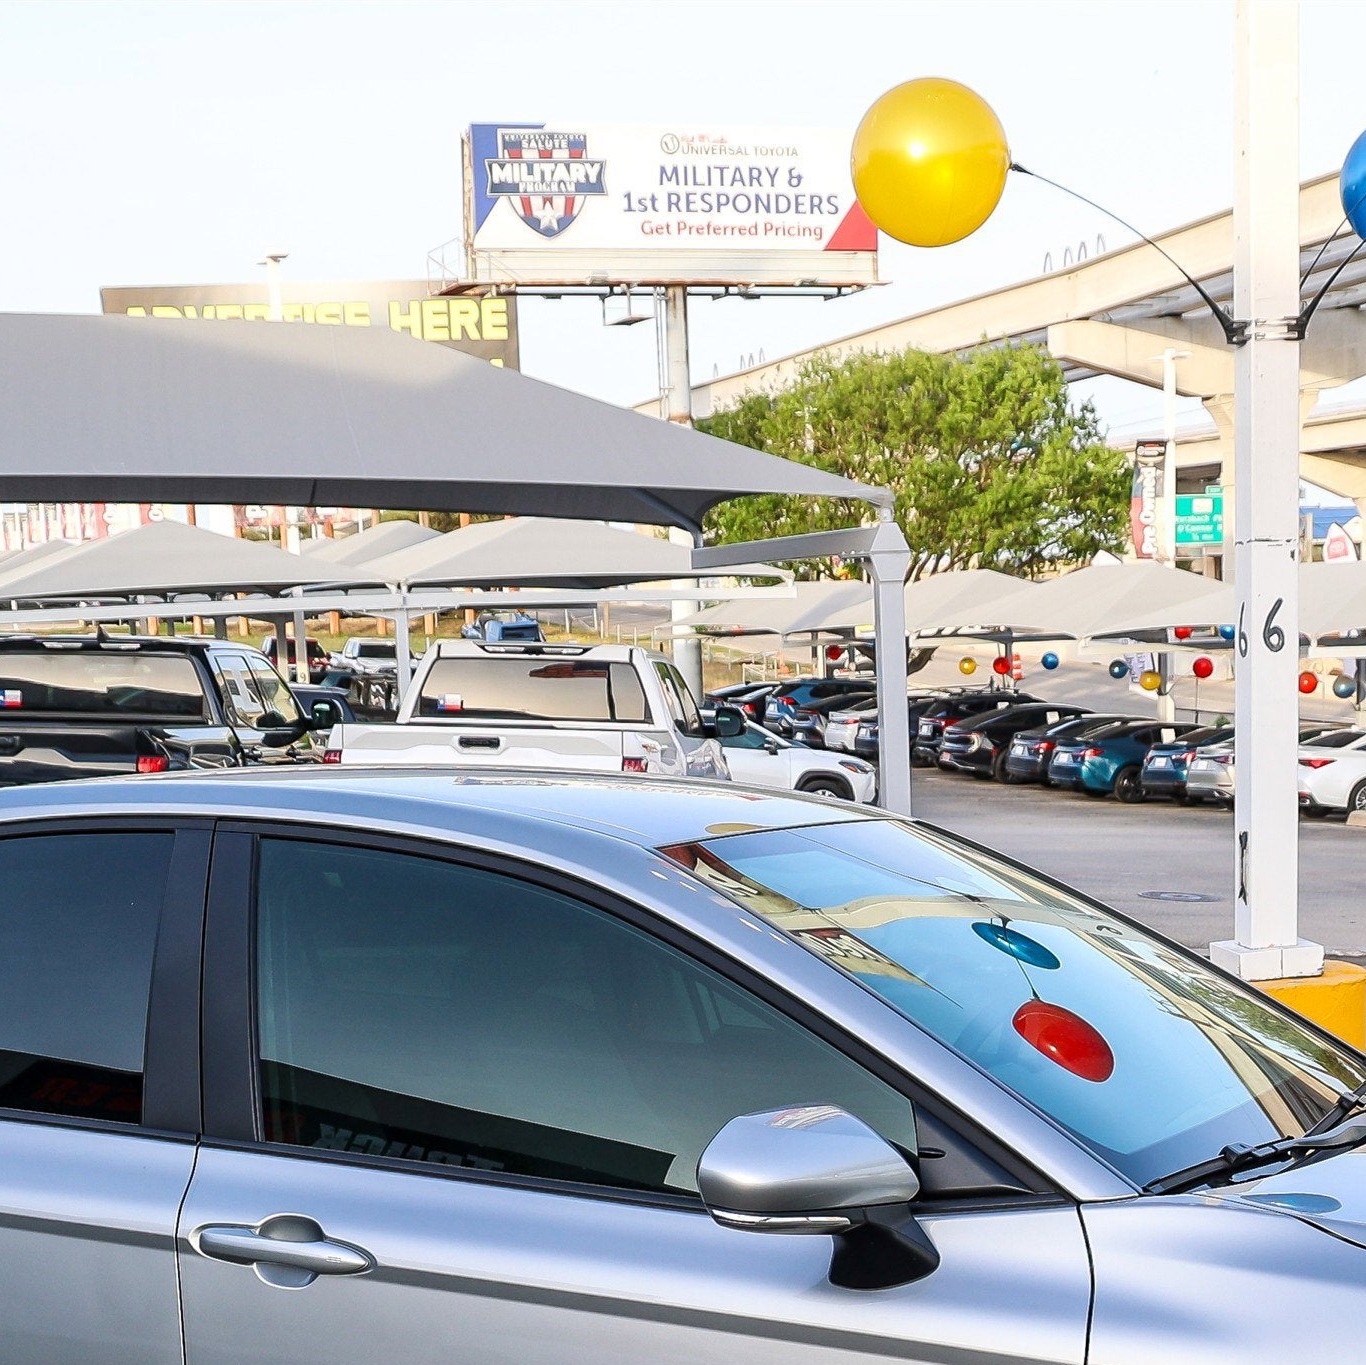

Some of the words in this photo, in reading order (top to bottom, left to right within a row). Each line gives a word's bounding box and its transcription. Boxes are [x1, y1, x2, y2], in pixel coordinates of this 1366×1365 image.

[521, 139, 569, 150] SALUTE
[681, 144, 750, 156] UNIVERSAL
[754, 146, 799, 157] TOYOTA
[491, 162, 601, 184] MILITARY
[659, 165, 780, 188] MILITARY
[787, 166, 803, 188] &
[623, 191, 659, 213] 1st
[667, 192, 840, 215] RESPONDERS
[641, 220, 672, 235] Get
[677, 221, 759, 236] Preferred
[764, 222, 823, 241] Pricing
[389, 298, 509, 341] HERE
[1141, 524, 1158, 555] Pre
[1263, 597, 1286, 653] 6
